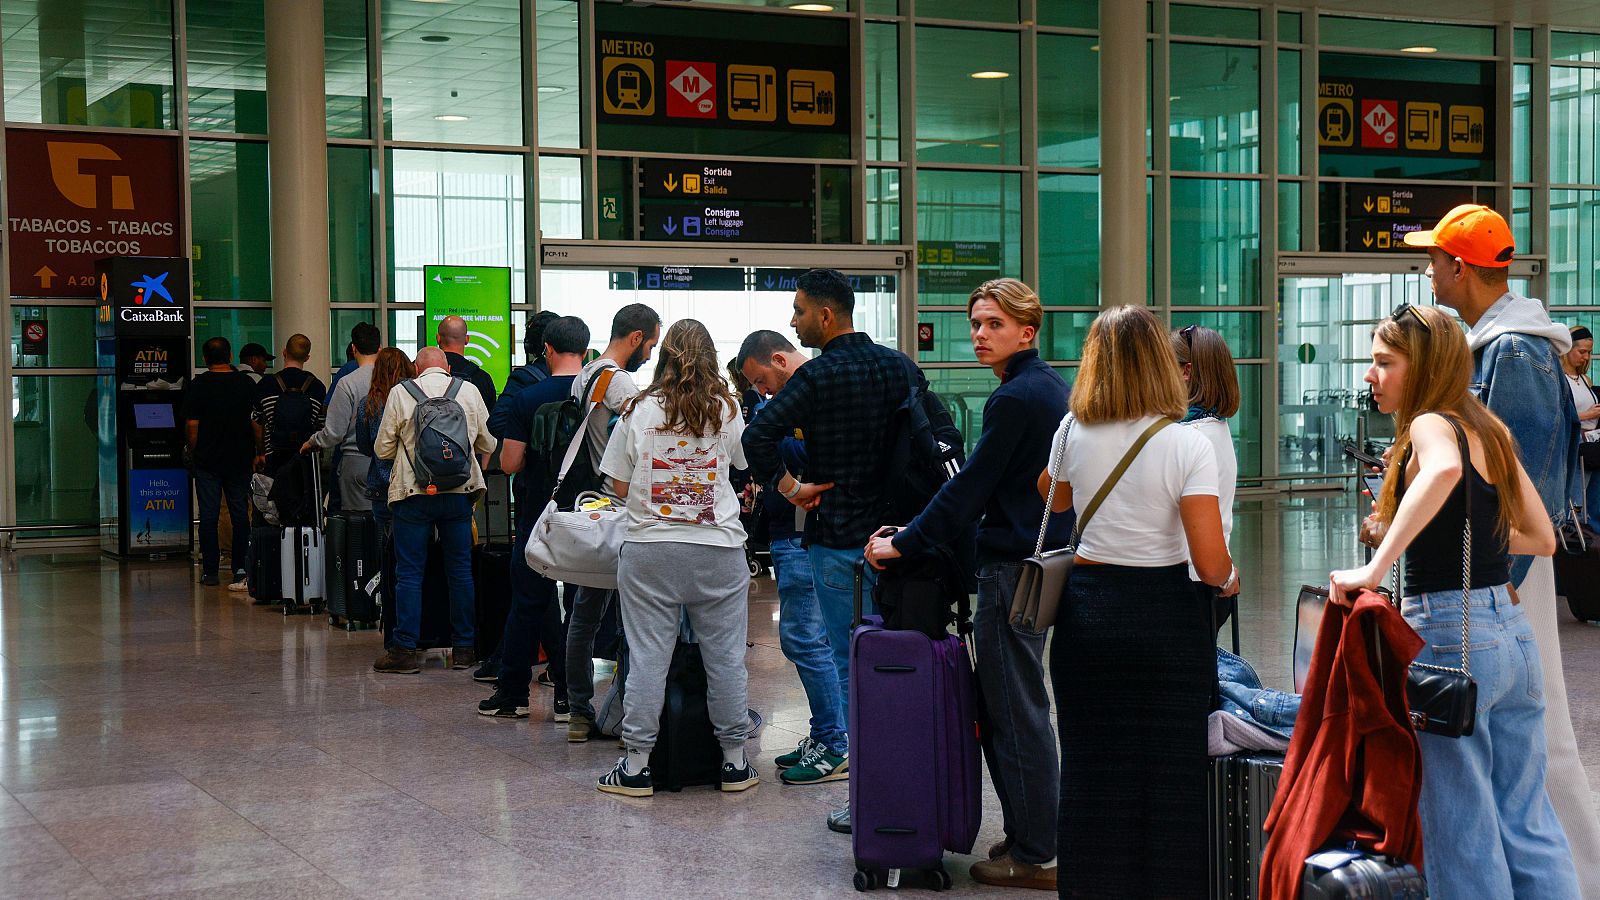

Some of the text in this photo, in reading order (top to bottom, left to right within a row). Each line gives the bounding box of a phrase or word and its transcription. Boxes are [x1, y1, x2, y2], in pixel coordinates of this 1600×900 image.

[601, 39, 655, 57] METRO
[682, 75, 700, 94] M
[1319, 83, 1354, 97] METRO
[1373, 112, 1386, 127] M
[703, 166, 732, 177] Sortida
[703, 177, 715, 185] Exit
[703, 185, 728, 195] Salida
[1392, 190, 1413, 199] Sortida
[704, 207, 740, 219] Consigna
[9, 217, 92, 235] TABACOS
[108, 220, 174, 236] TABACS
[704, 218, 744, 228] Left luggage
[705, 227, 740, 238] Consigna
[45, 238, 141, 255] TOBACCOS
[662, 266, 690, 275] Consigna
[67, 275, 96, 287] A 20
[674, 274, 693, 282] luggage
[663, 281, 690, 289] Consigna
[120, 308, 185, 322] CaixaBank
[135, 350, 168, 361] ATM
[149, 479, 171, 488] Hello,
[140, 488, 154, 497] this
[162, 489, 180, 497] your
[145, 499, 175, 511] ATM
